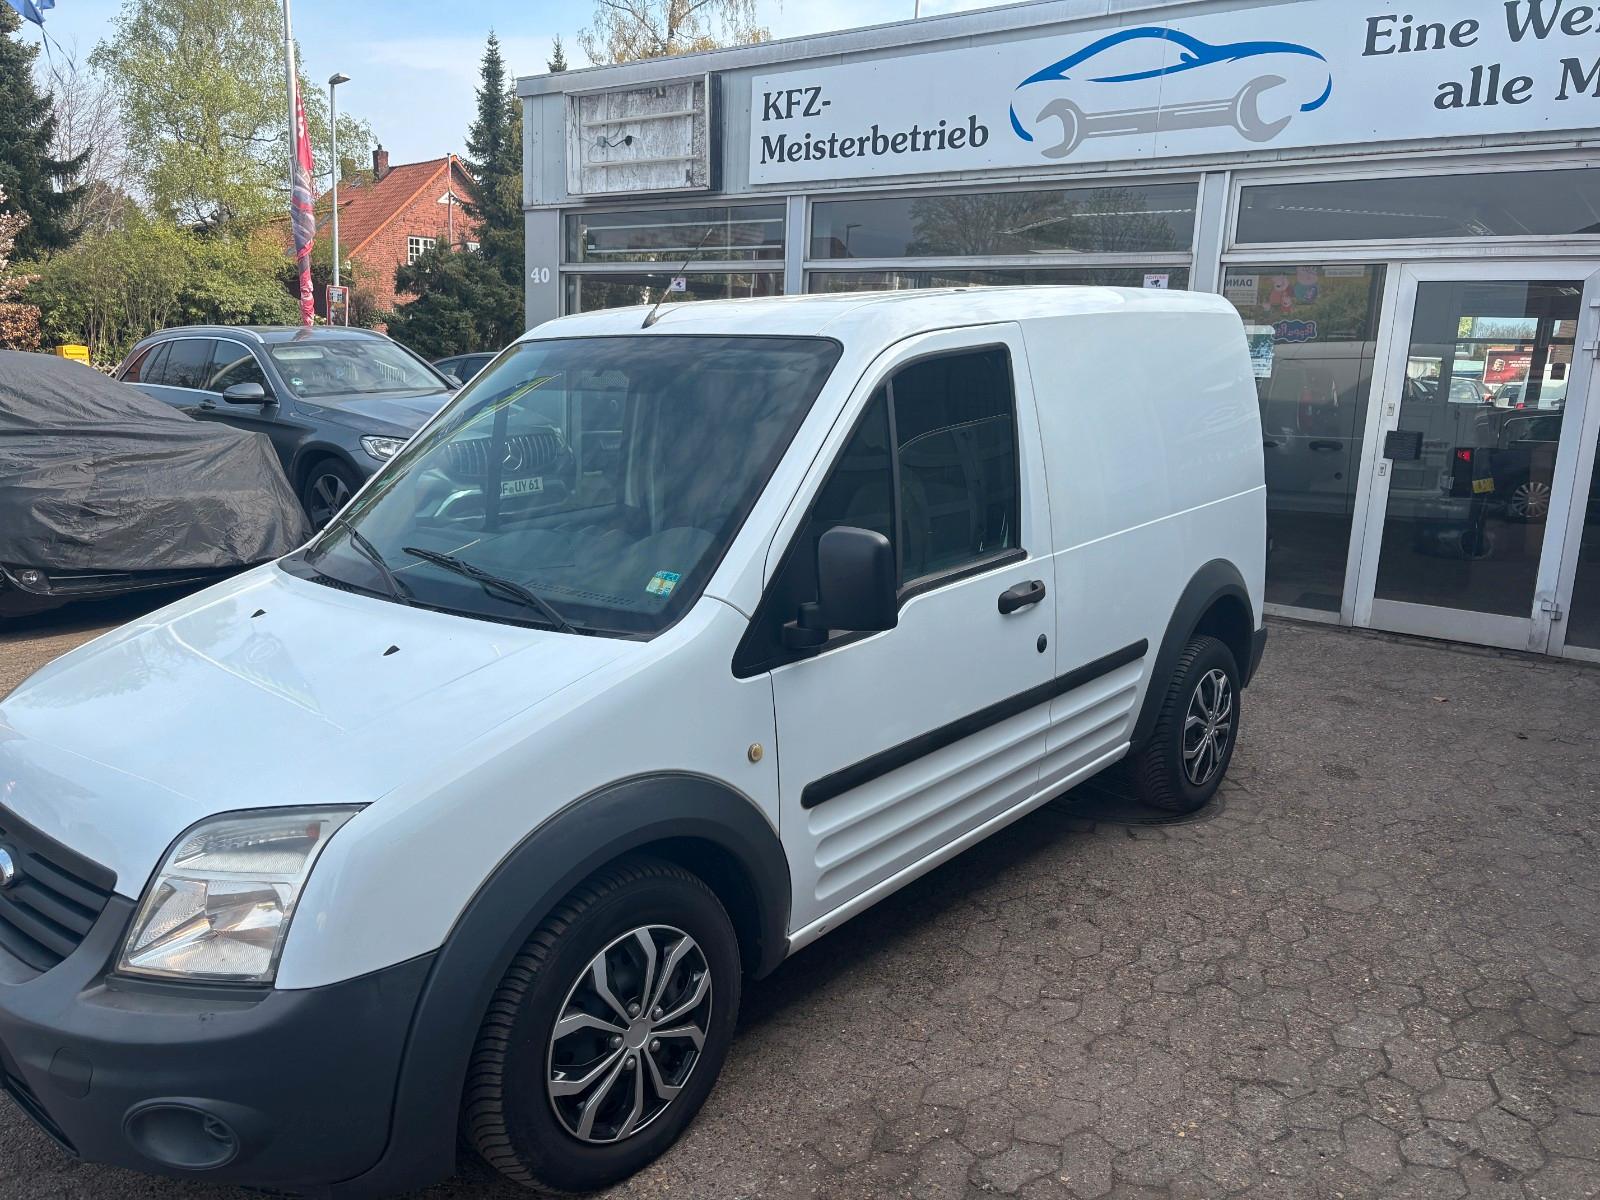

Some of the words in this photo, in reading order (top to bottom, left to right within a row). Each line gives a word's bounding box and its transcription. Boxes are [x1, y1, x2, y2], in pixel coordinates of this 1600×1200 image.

[1362, 15, 1480, 56] Eine
[1504, 0, 1600, 42] We
[762, 86, 832, 121] KFZ-
[1433, 64, 1534, 110] alle
[760, 114, 989, 164] Meisterbetrieb
[530, 267, 550, 284] 40
[529, 478, 540, 490] 61
